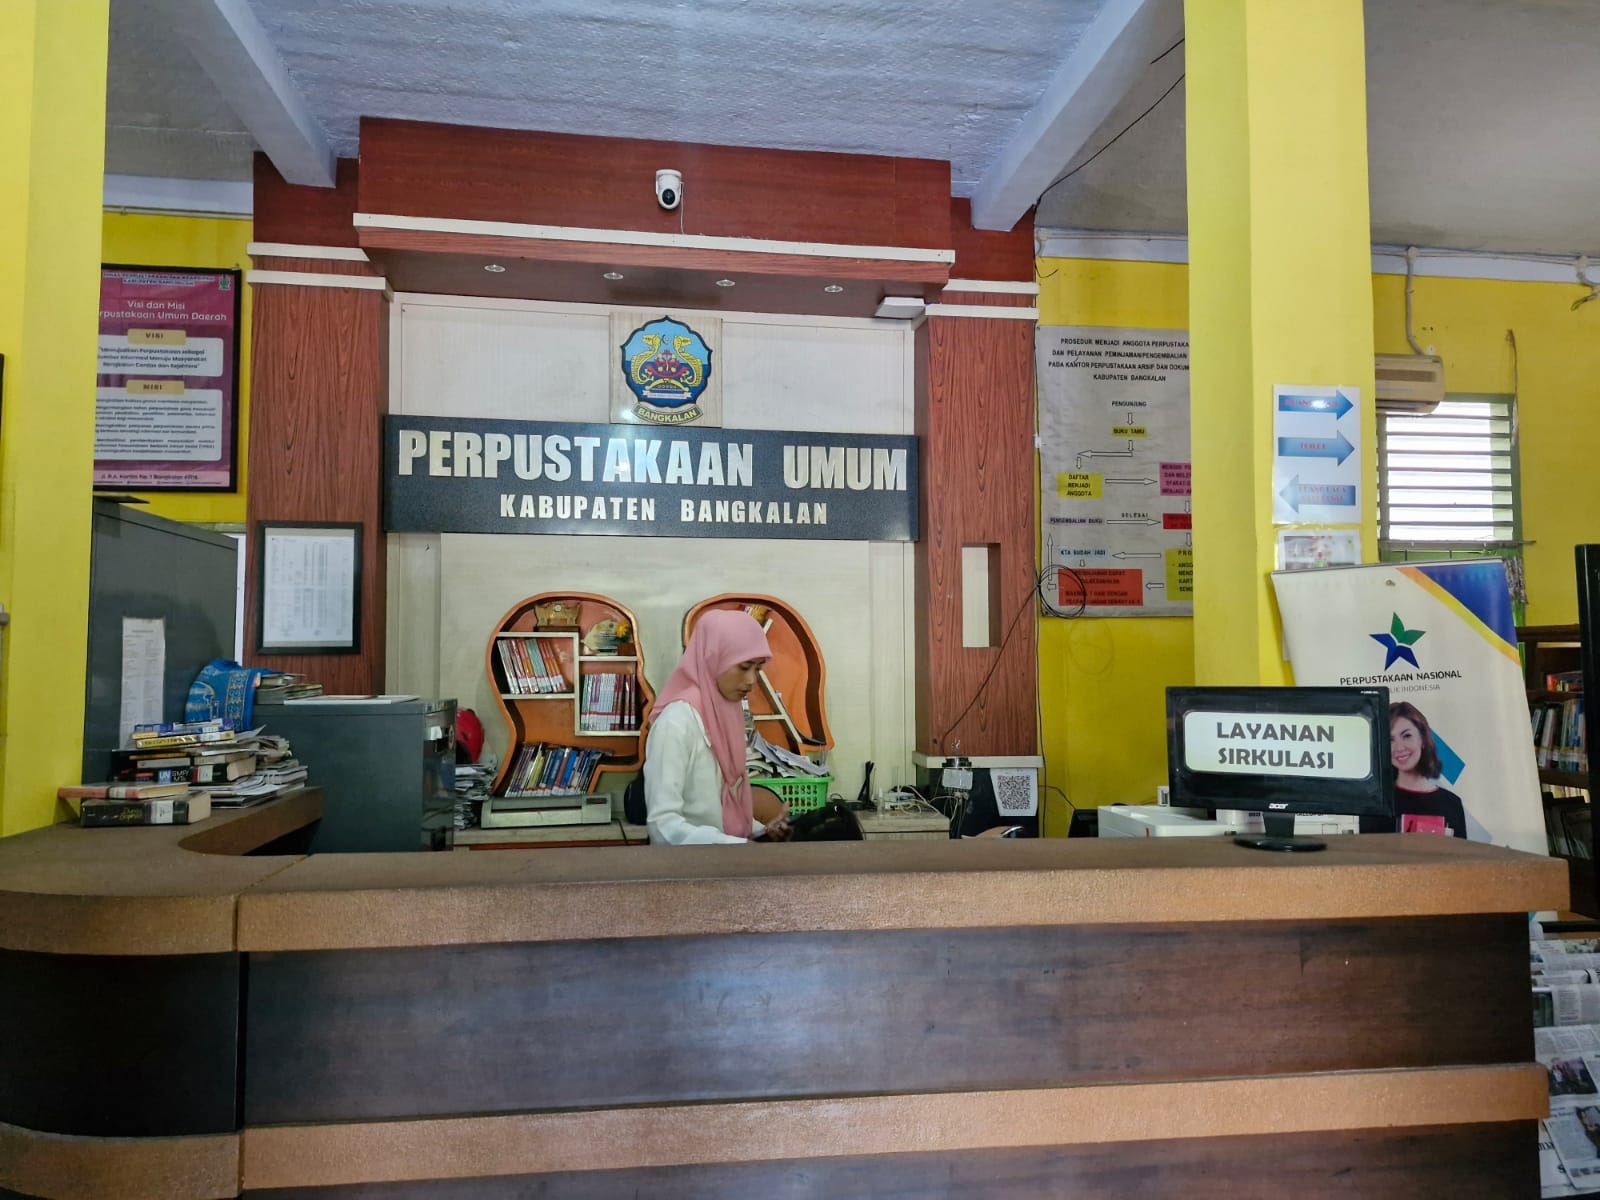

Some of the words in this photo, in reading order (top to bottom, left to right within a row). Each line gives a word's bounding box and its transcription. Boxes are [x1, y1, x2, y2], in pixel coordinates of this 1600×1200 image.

[128, 300, 144, 308] Visi
[146, 301, 165, 309] dan
[168, 301, 185, 310] Misi
[158, 311, 189, 320] Umum
[191, 312, 227, 321] Daerah
[1065, 361, 1089, 369] KANTOR
[1091, 362, 1136, 370] PERPUSTAKAAN
[1130, 374, 1167, 382] BANGKALAN
[638, 407, 697, 423] BANGKALAN
[399, 429, 754, 488] PERPUSTAKAAN
[782, 444, 908, 491] UMUM
[500, 493, 656, 522] KABUPATEN
[680, 499, 828, 525] BANGKALAN
[1340, 673, 1413, 686] PERPUSTAKAAN
[1416, 670, 1462, 681] NASIONAL
[1401, 683, 1441, 693] INDONESIA
[1216, 721, 1335, 743] LAYANAN
[1218, 747, 1334, 770] SIRKULASI
[1268, 802, 1289, 810] acer
